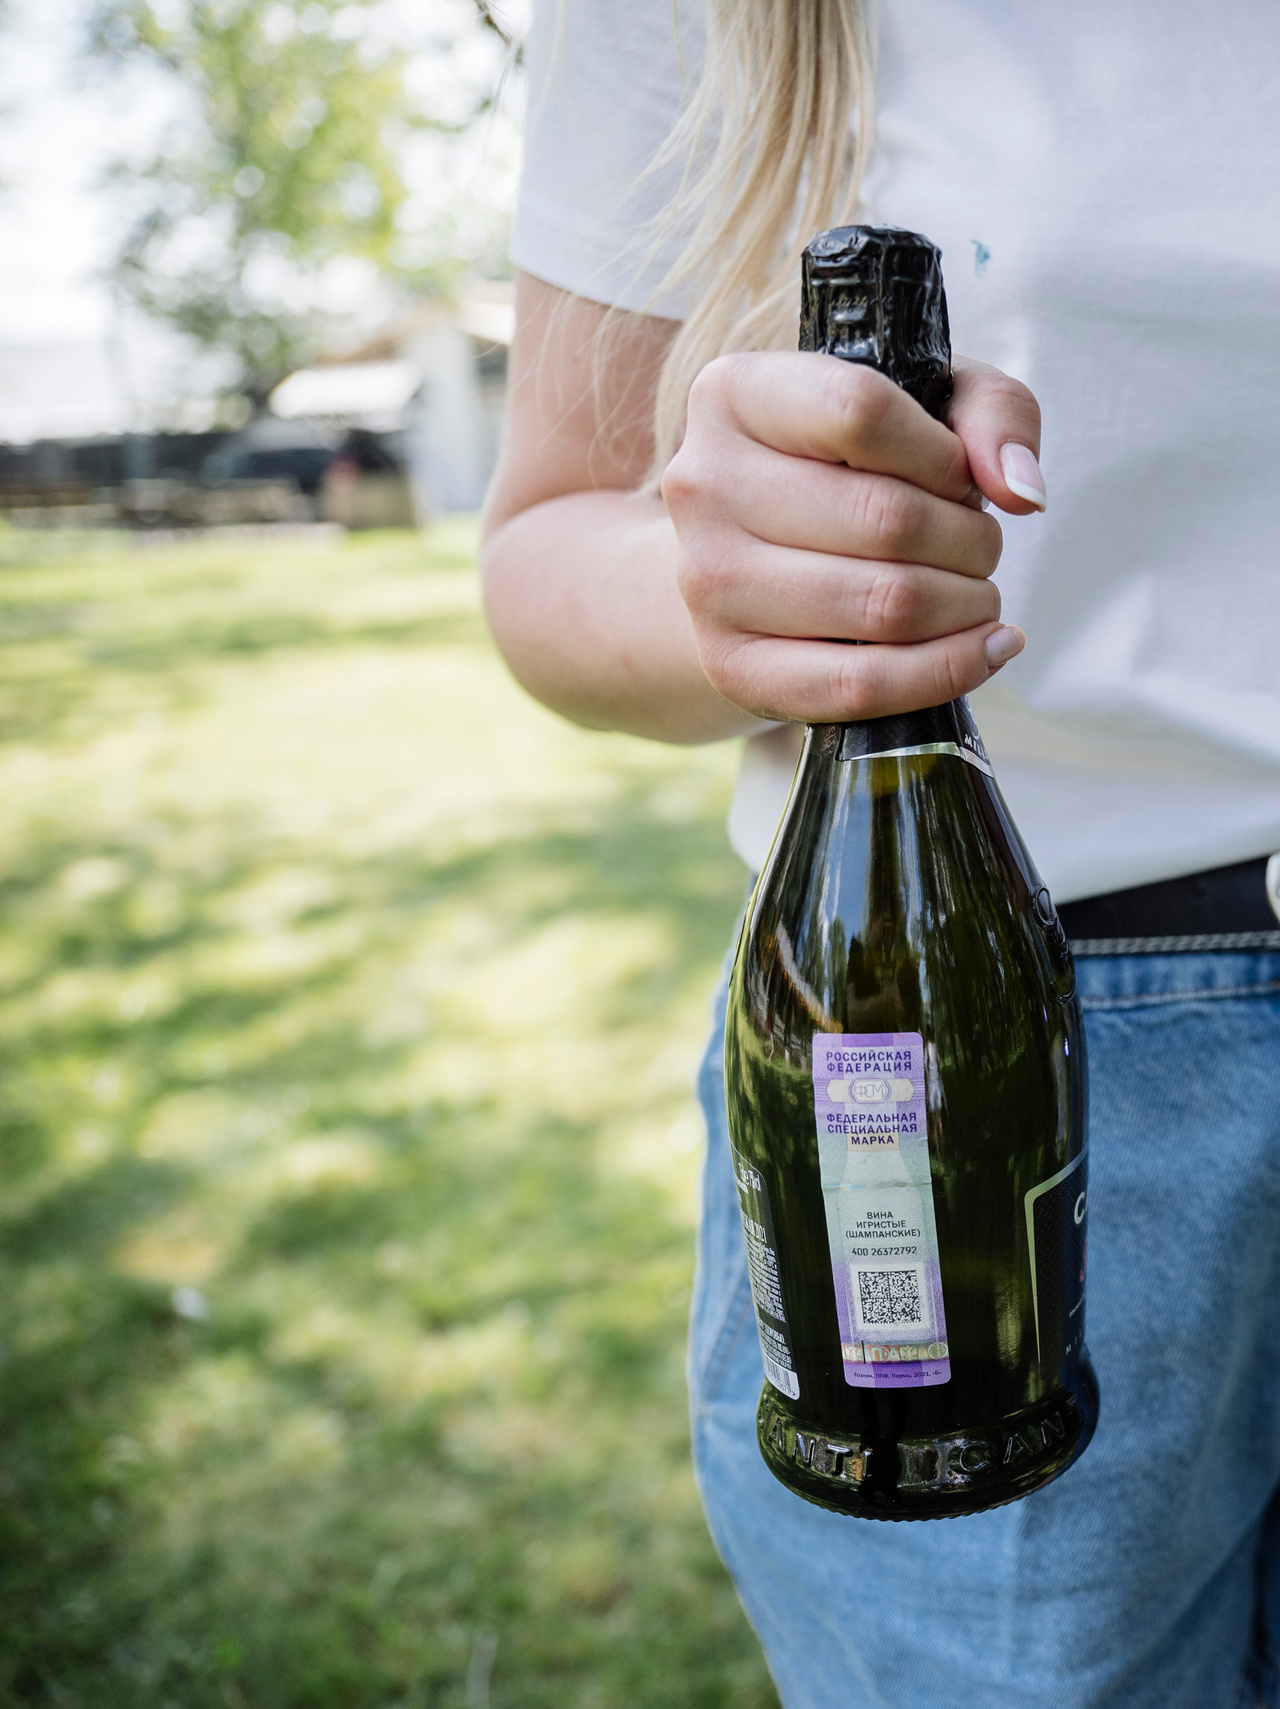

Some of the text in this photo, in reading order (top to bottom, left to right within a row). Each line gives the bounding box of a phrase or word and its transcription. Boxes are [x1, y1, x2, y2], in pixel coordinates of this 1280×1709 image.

[826, 1050, 912, 1062] РОССИЙСКАЯ
[827, 1061, 912, 1074] ФЕДЕРАЦИЯ
[826, 1112, 917, 1124] ФЕДЕРАЛЬНАЯ
[827, 1123, 918, 1136] СПЕЦИАЛЬНАЯ
[851, 1135, 895, 1145] МАРКА
[867, 1211, 894, 1219] ВИНА
[856, 1220, 906, 1229] ИГРИСТЫЕ
[845, 1229, 921, 1239] (ШАМПАНСКИЕ)
[851, 1246, 918, 1256] 400 26372792
